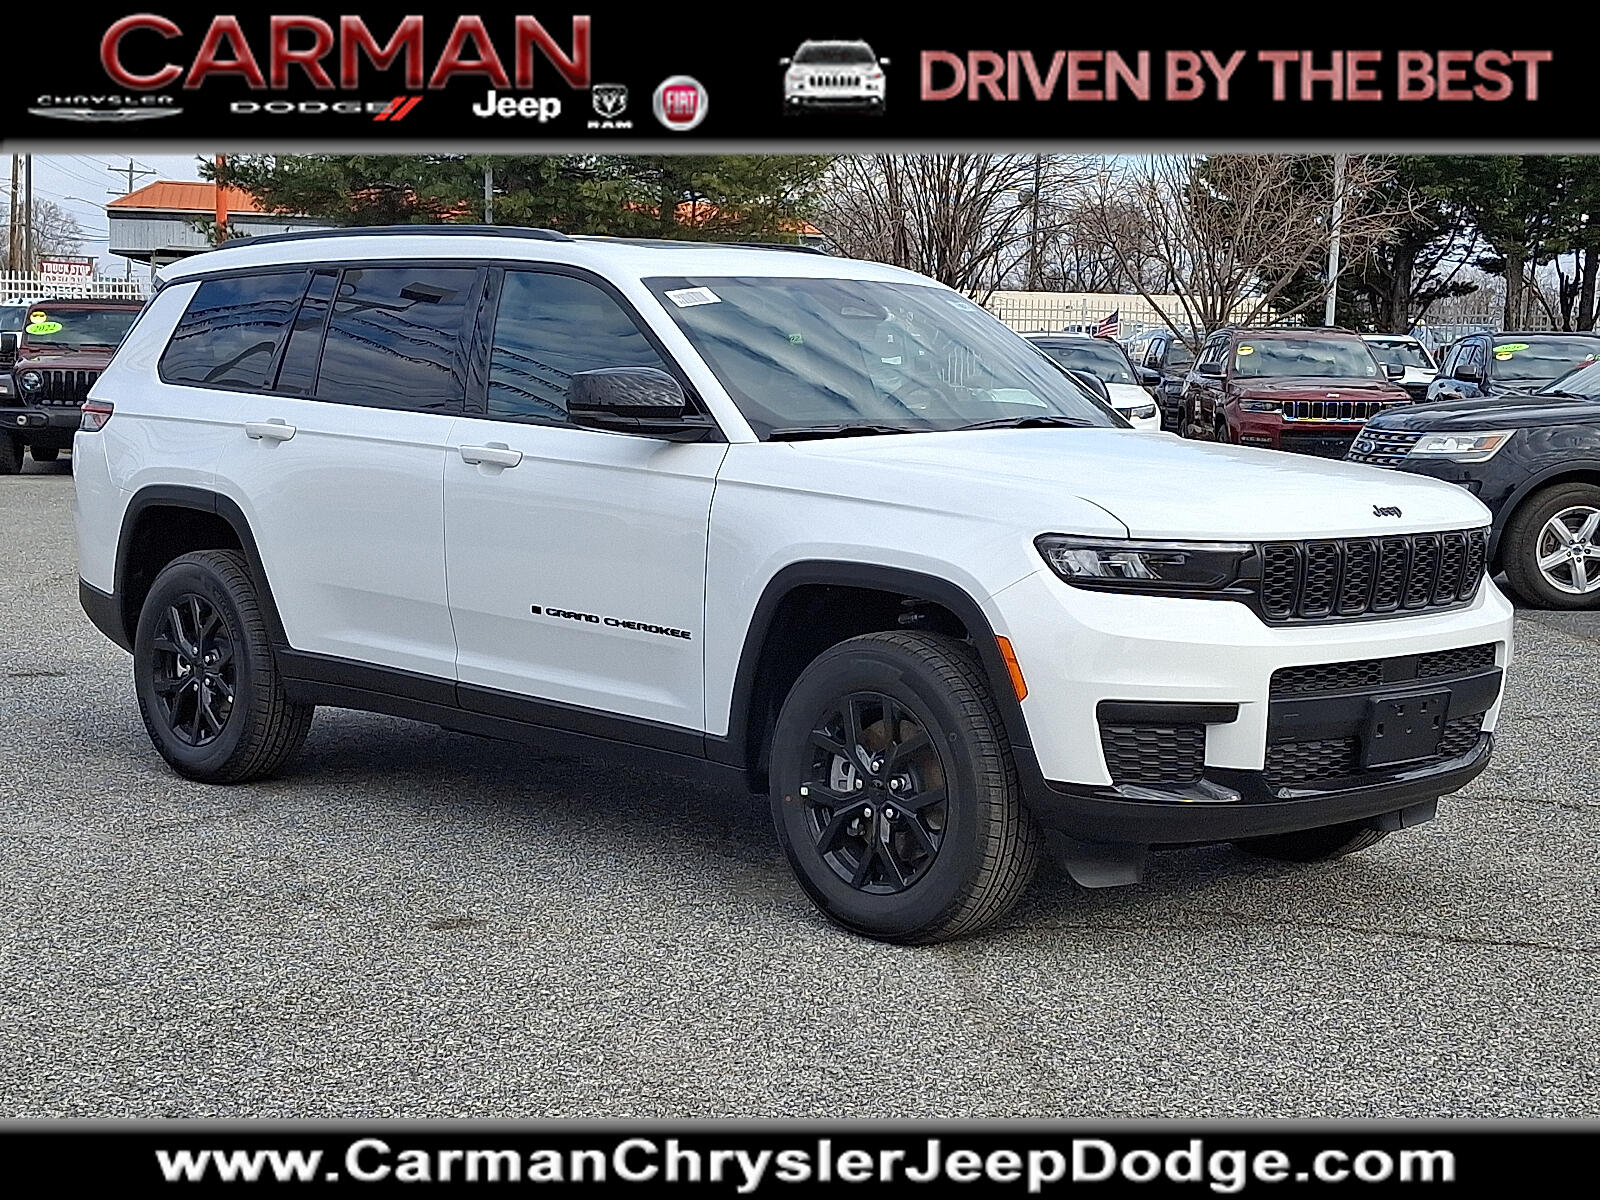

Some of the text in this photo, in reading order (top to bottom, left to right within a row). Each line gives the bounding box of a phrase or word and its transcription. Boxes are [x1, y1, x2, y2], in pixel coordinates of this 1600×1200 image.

[42, 262, 91, 277] TRUCK STOP
[1372, 504, 1403, 518] Jeep
[545, 606, 692, 640] GRAND CHEROKEE
